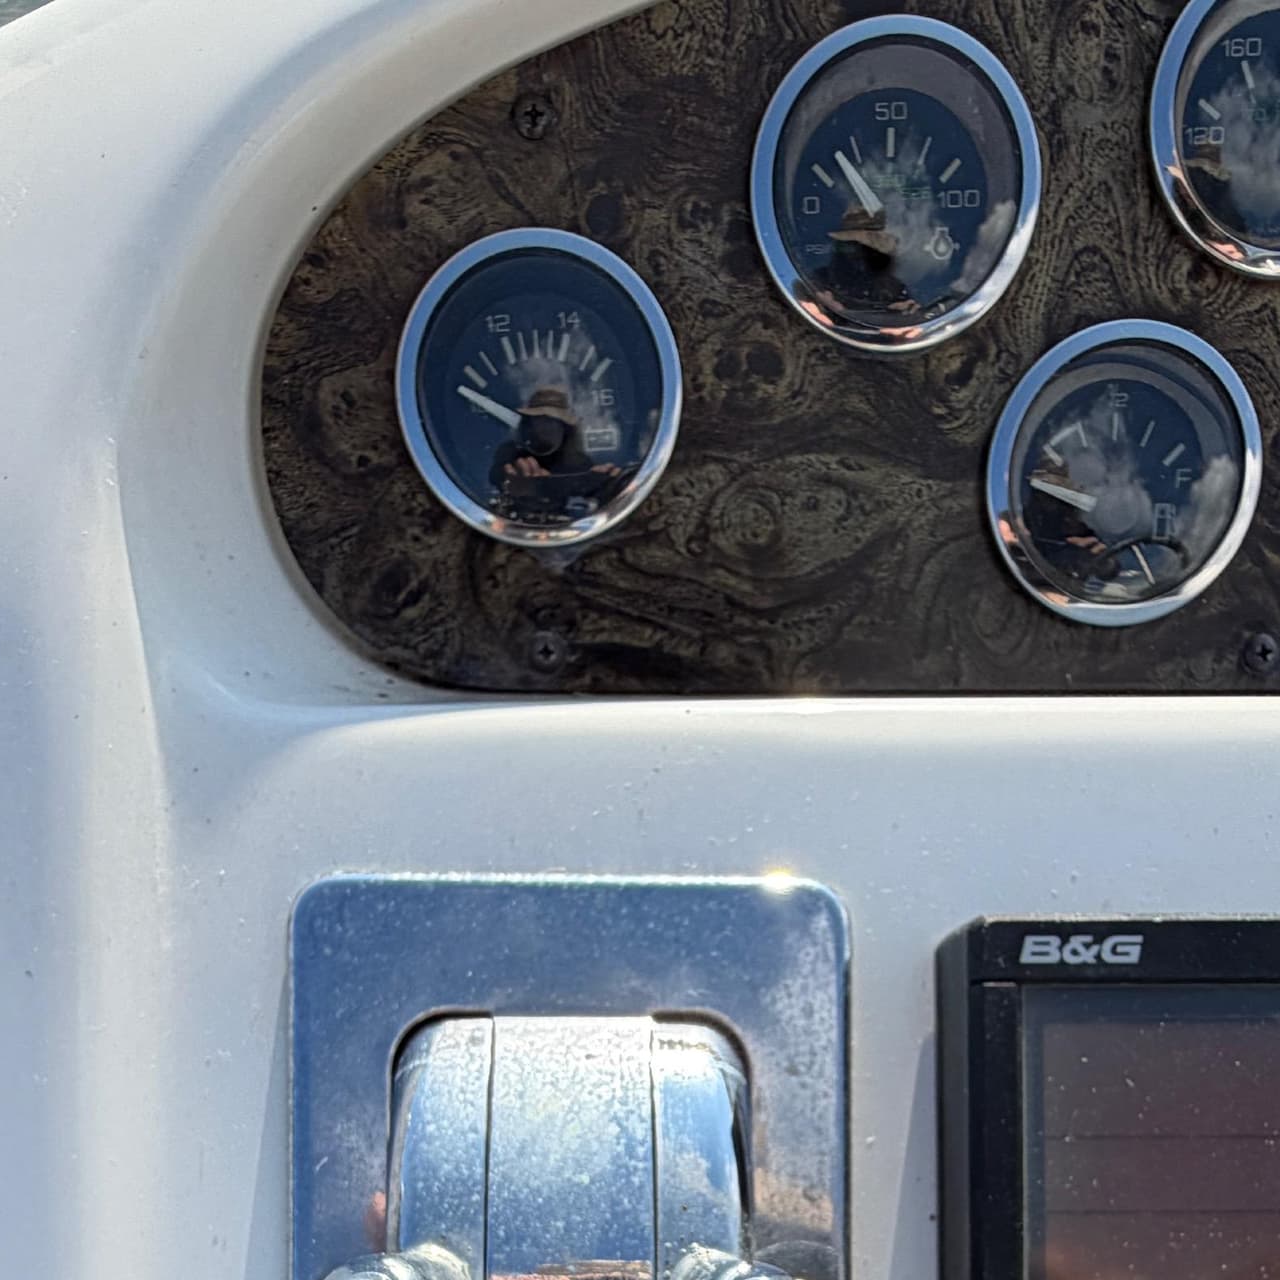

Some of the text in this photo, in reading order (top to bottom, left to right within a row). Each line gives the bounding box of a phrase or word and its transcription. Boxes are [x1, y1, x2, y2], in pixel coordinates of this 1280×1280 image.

[1222, 37, 1262, 57] 160
[874, 102, 908, 121] 50
[1184, 126, 1224, 144] 120
[802, 196, 820, 215] 0
[937, 189, 980, 209] 100
[485, 314, 511, 332] 12
[557, 311, 581, 329] 14
[1175, 468, 1192, 489] F
[1019, 934, 1144, 964] B&G
